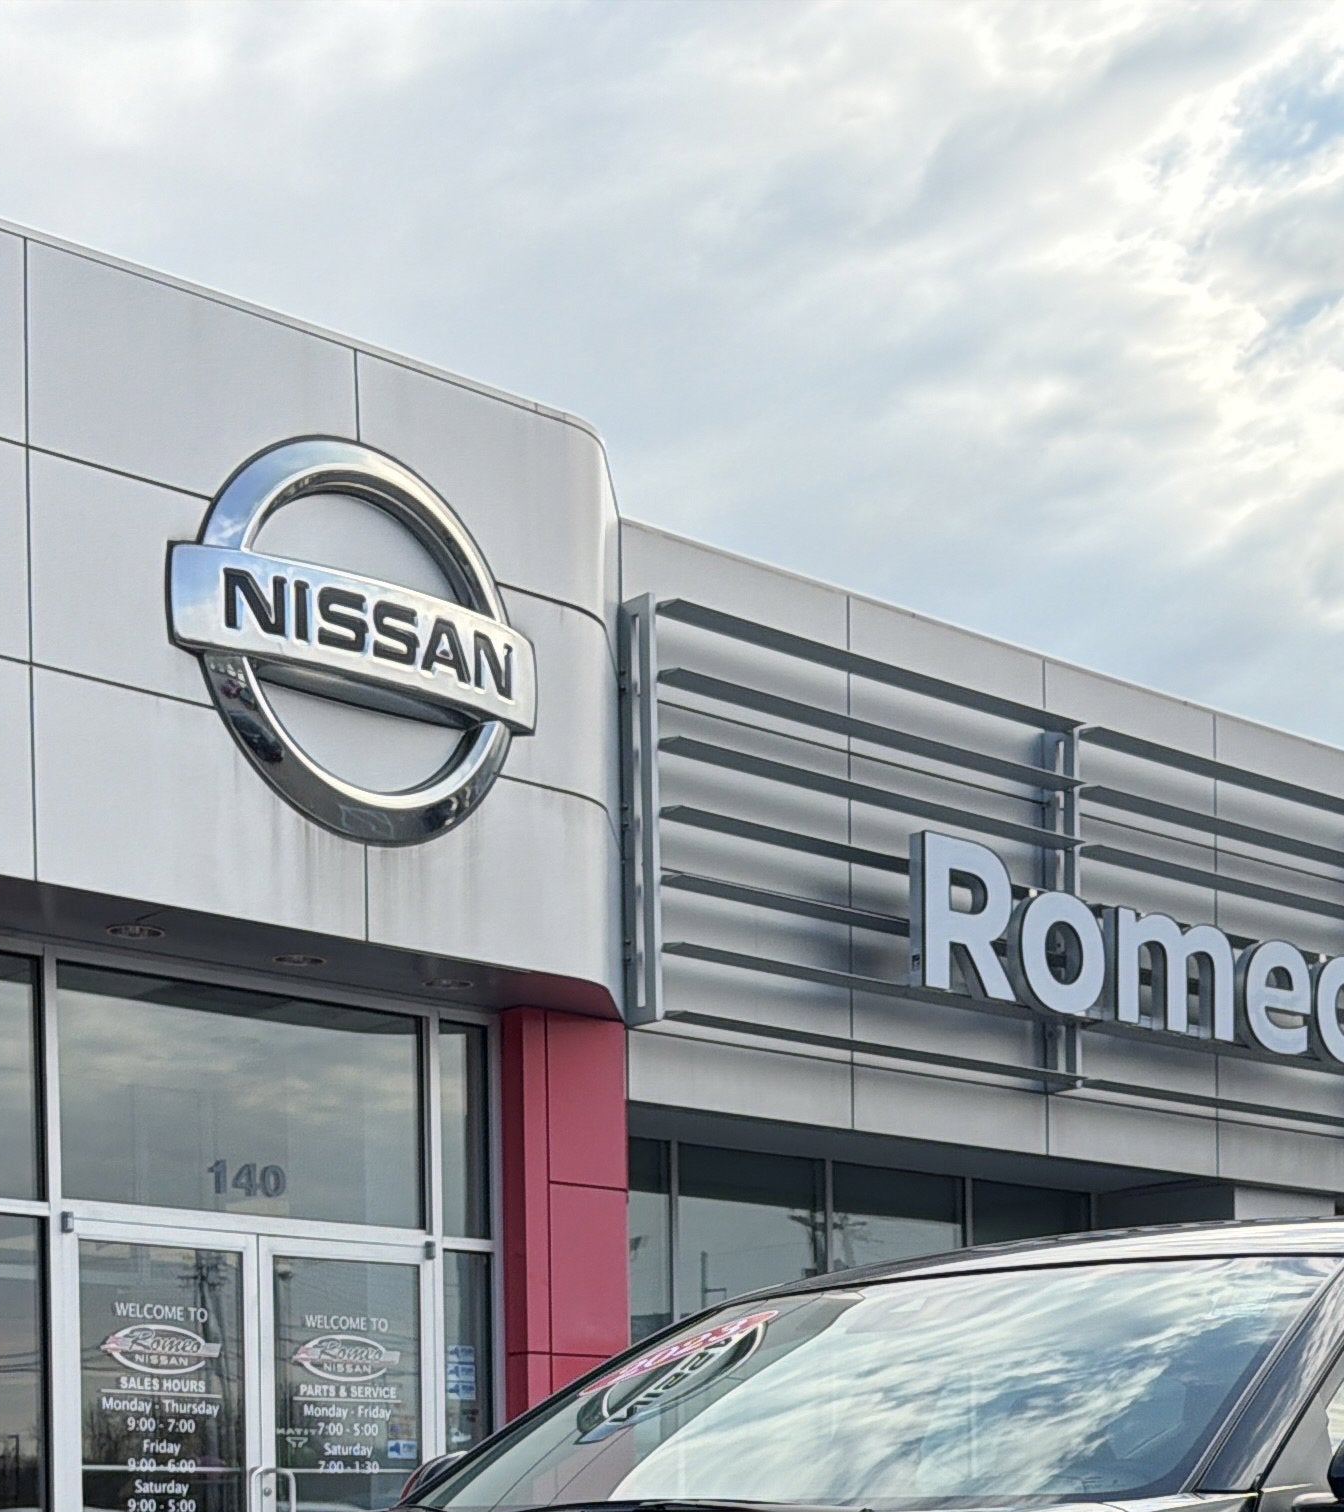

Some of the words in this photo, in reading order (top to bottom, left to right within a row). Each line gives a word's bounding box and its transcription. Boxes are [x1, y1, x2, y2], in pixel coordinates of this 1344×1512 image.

[222, 566, 514, 701] NISSAN
[207, 1158, 287, 1198] 140
[114, 1301, 185, 1322] WELCOME
[187, 1306, 208, 1323] TO
[304, 1314, 368, 1331] WELCOME
[369, 1317, 389, 1333] TO
[128, 1327, 202, 1353] Romeo
[135, 1353, 189, 1366] NISSAN
[323, 1362, 372, 1374] NISSAN
[119, 1376, 160, 1391] SALES
[162, 1378, 206, 1393] HOURS
[299, 1383, 336, 1398] PARTS
[339, 1385, 348, 1398] &
[350, 1385, 397, 1399] SERVICE
[101, 1396, 152, 1415] Monday
[161, 1399, 220, 1418] Thursday
[303, 1403, 348, 1420] Monday
[357, 1404, 392, 1421] Friday
[127, 1416, 156, 1432] 9:00
[167, 1418, 196, 1434] 7:00
[317, 1421, 344, 1437] 7:00
[353, 1422, 379, 1437] 5:00
[142, 1438, 181, 1456] Friday
[323, 1442, 373, 1459] Saturday
[127, 1457, 157, 1473] 9:00
[318, 1460, 344, 1474] 7:00
[134, 1479, 190, 1497] Saturday
[127, 1498, 157, 1512] 9:00
